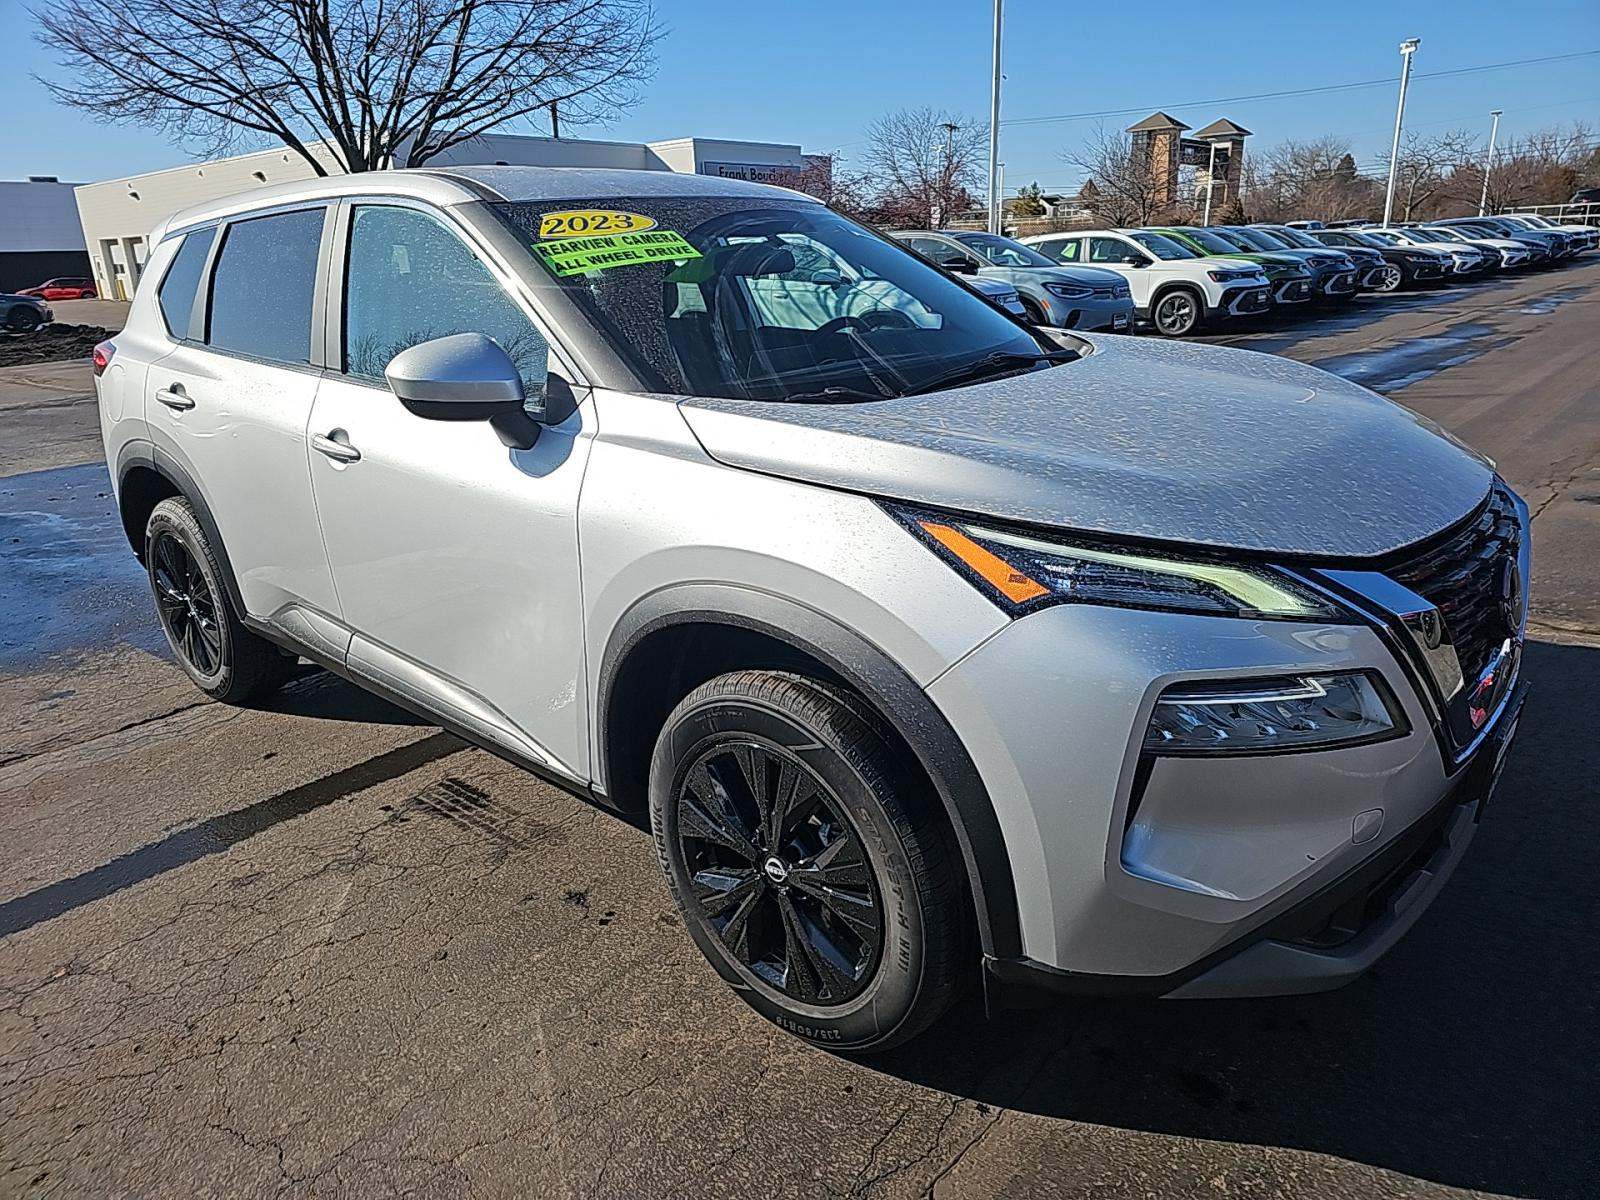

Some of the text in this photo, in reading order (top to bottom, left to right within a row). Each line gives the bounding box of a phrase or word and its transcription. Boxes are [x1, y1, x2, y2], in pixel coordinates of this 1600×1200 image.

[719, 166, 747, 180] Frank
[544, 215, 634, 235] 2023
[537, 232, 685, 257] REARVIEW CAMERA
[553, 245, 694, 272] ALL WHEEL DRIVE
